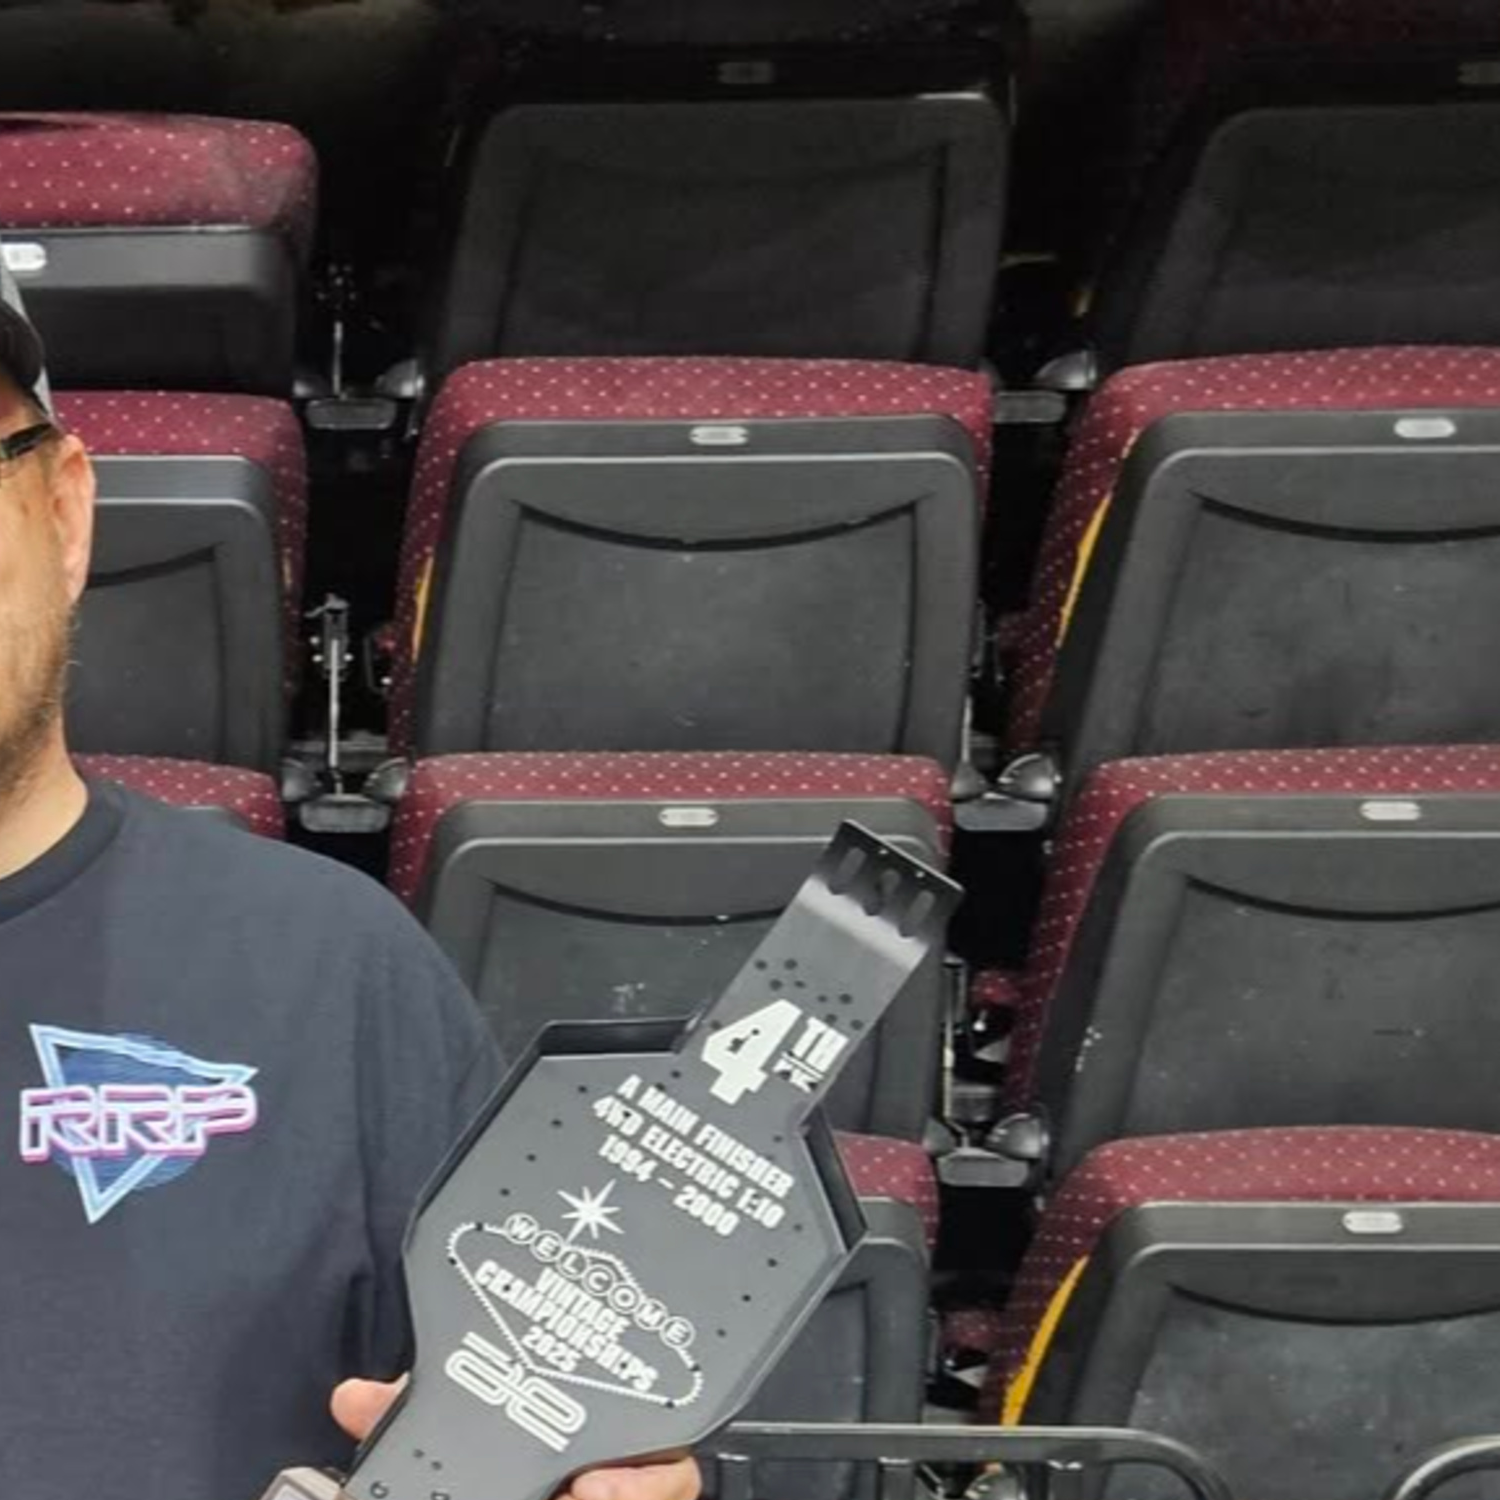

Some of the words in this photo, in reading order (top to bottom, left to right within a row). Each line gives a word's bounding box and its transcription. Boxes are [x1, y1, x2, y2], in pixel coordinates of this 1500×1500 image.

[20, 1084, 258, 1165] RRP
[591, 1094, 645, 1137] 4WD
[639, 1123, 742, 1199] ELECTRIC
[735, 1186, 786, 1229] 1:10
[617, 1073, 643, 1100] A
[637, 1085, 700, 1136] MAIN
[693, 1122, 795, 1199] FINISHER
[598, 1133, 658, 1182] 1994
[672, 1184, 740, 1237] 2000
[473, 1259, 659, 1392] CHAMPIONSHIPS
[505, 1214, 694, 1349] WELCOME
[534, 1266, 631, 1343] VINTAGE
[520, 1324, 582, 1373] 2025
